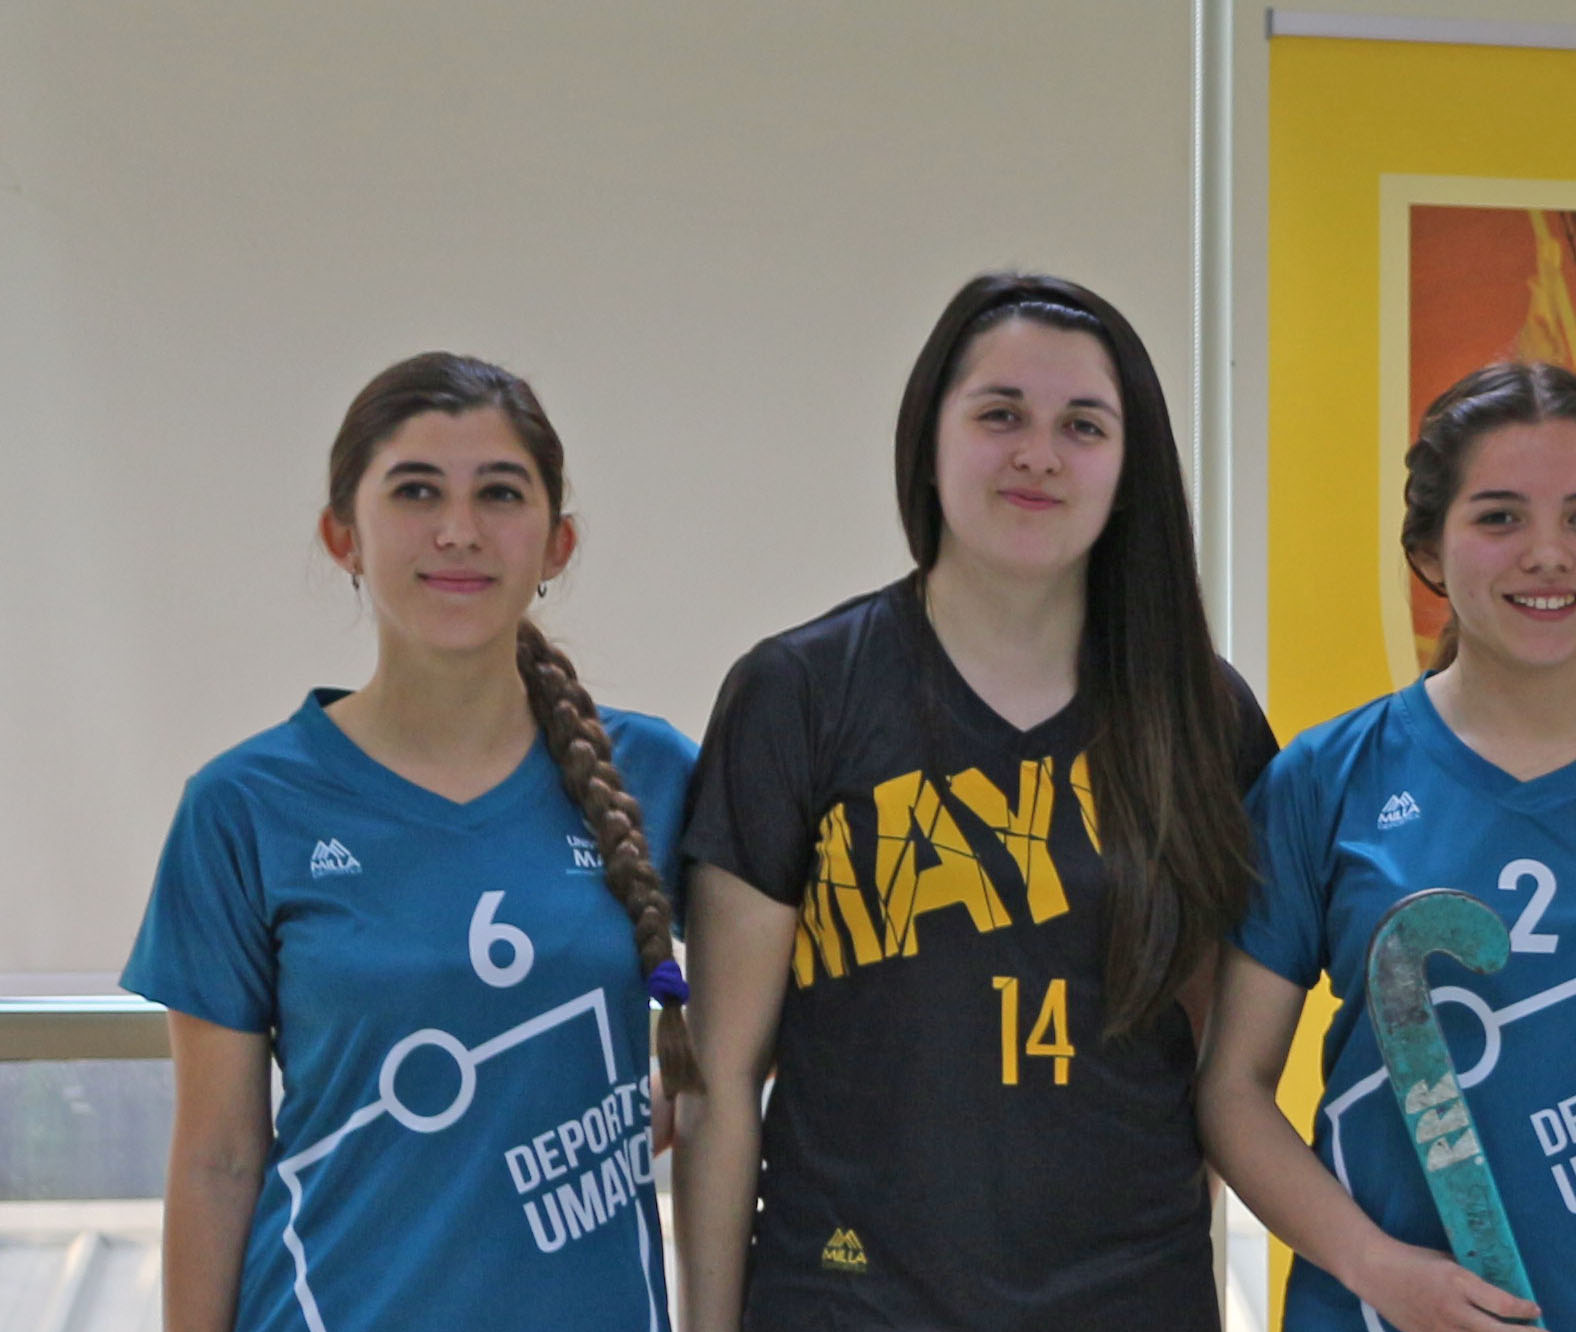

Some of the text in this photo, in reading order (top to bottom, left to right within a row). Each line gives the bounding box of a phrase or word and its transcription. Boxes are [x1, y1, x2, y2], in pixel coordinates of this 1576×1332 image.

[467, 890, 535, 988] 6
[1497, 859, 1560, 954] 2
[992, 976, 1075, 1086] 14
